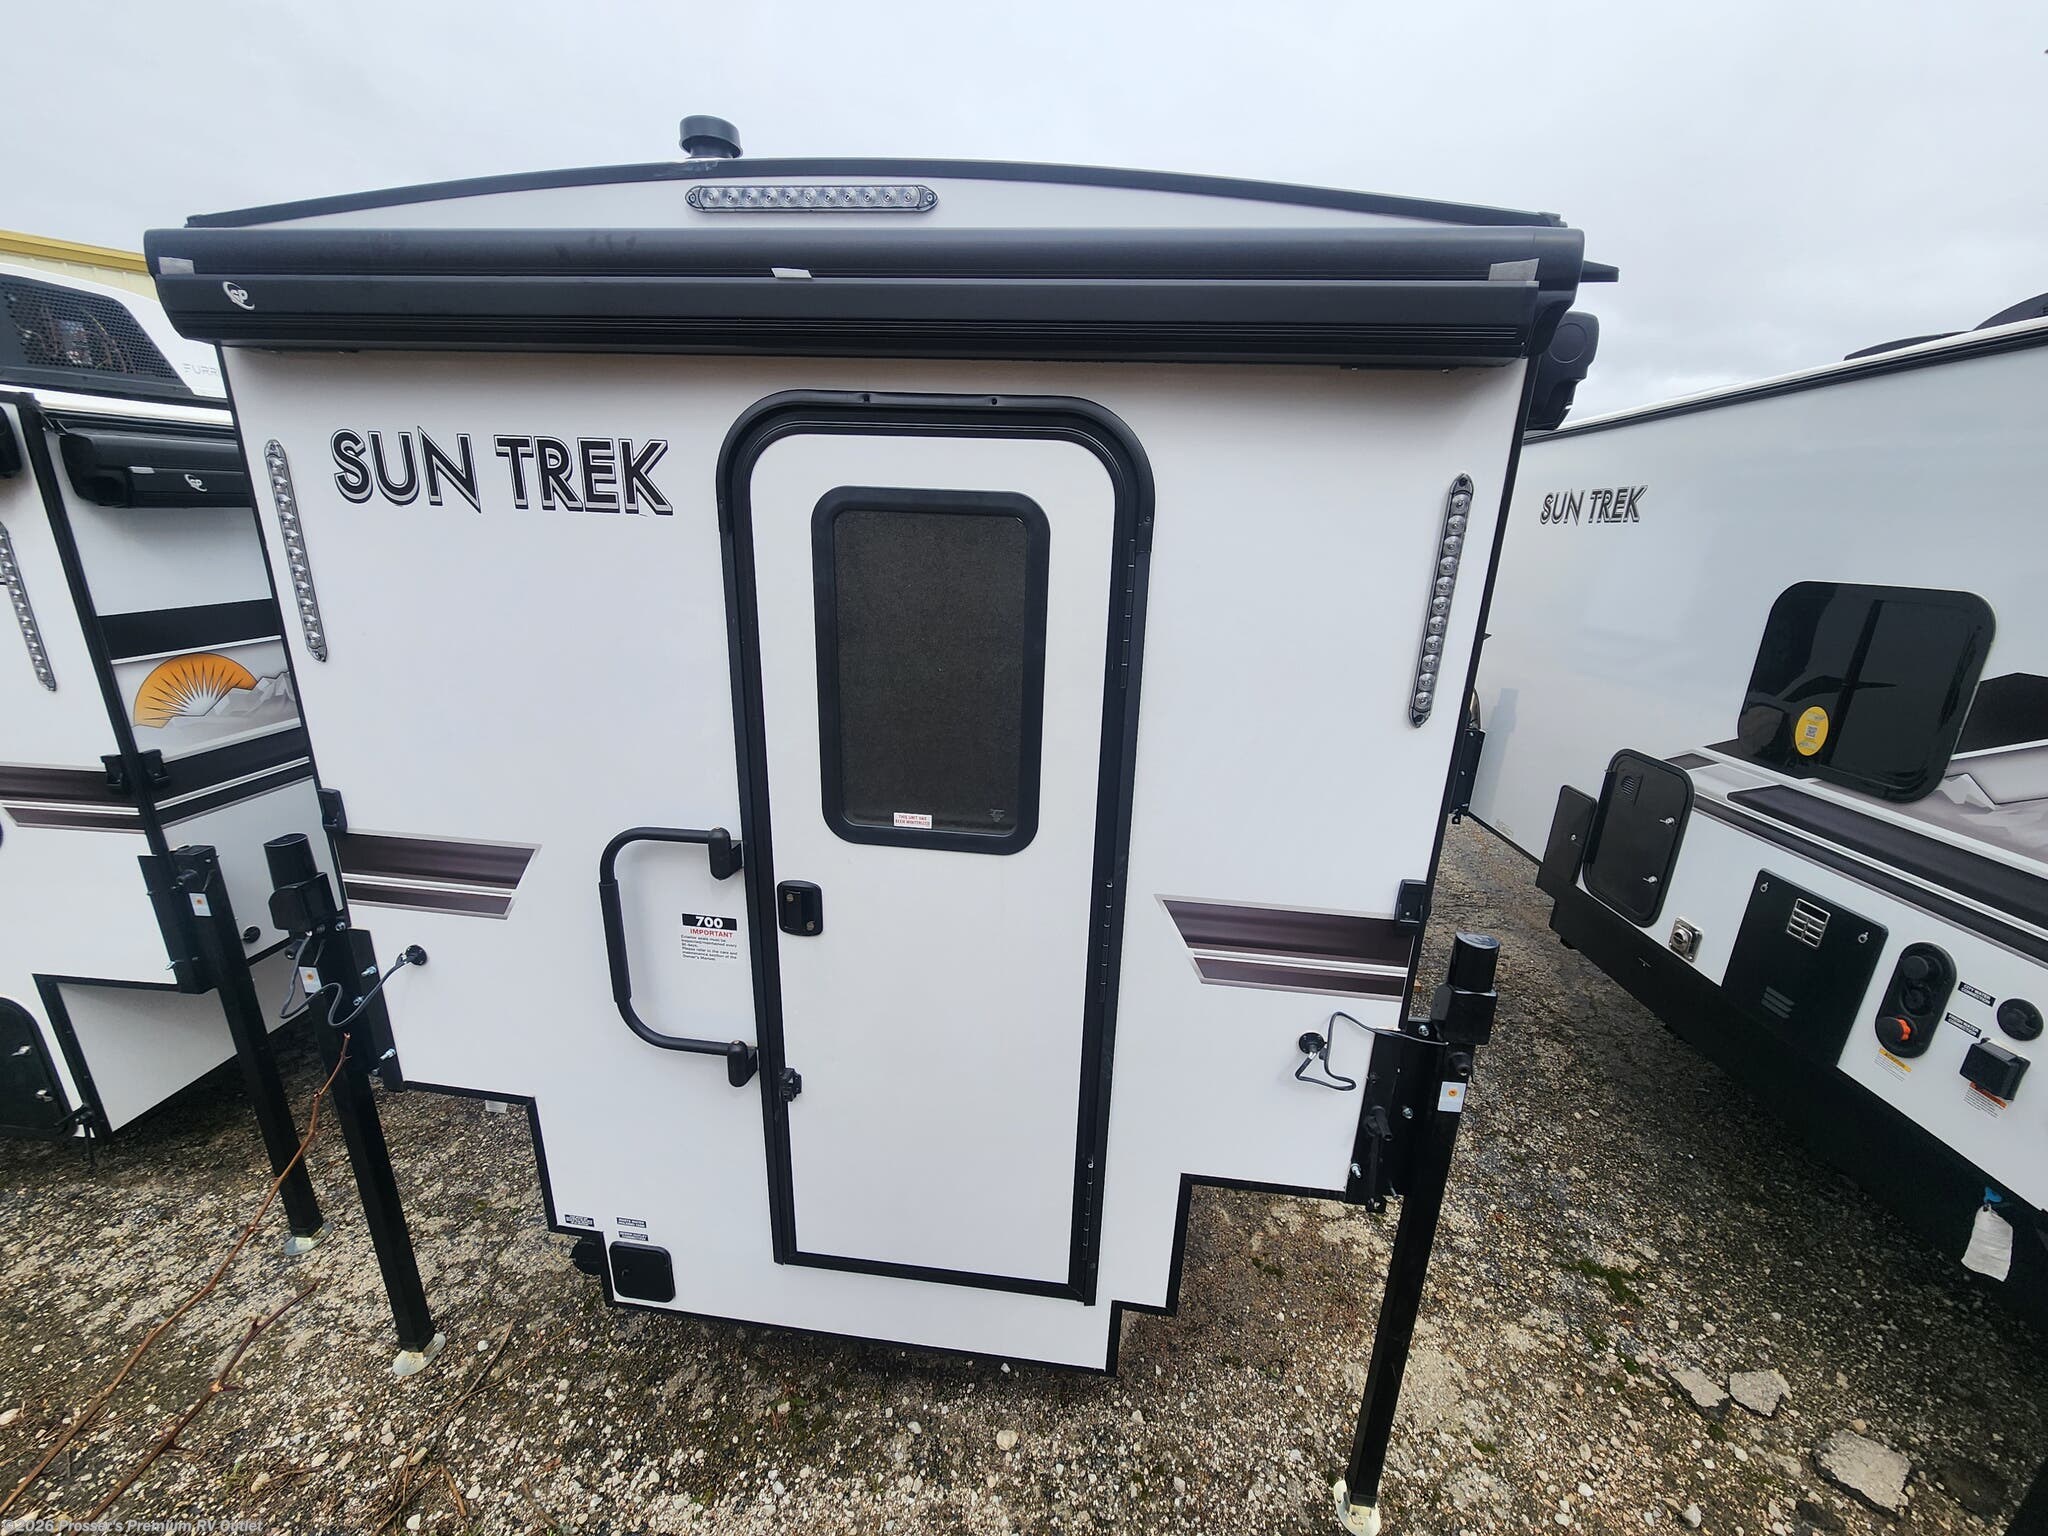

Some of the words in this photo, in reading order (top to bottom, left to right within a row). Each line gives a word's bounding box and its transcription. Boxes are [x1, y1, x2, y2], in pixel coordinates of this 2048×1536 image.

[330, 425, 482, 514] SUN
[493, 434, 674, 517] TREK
[1540, 488, 1585, 526] SUN
[1588, 485, 1648, 524] TREK
[690, 928, 733, 938] IMPORTANT
[695, 915, 724, 929] 700
